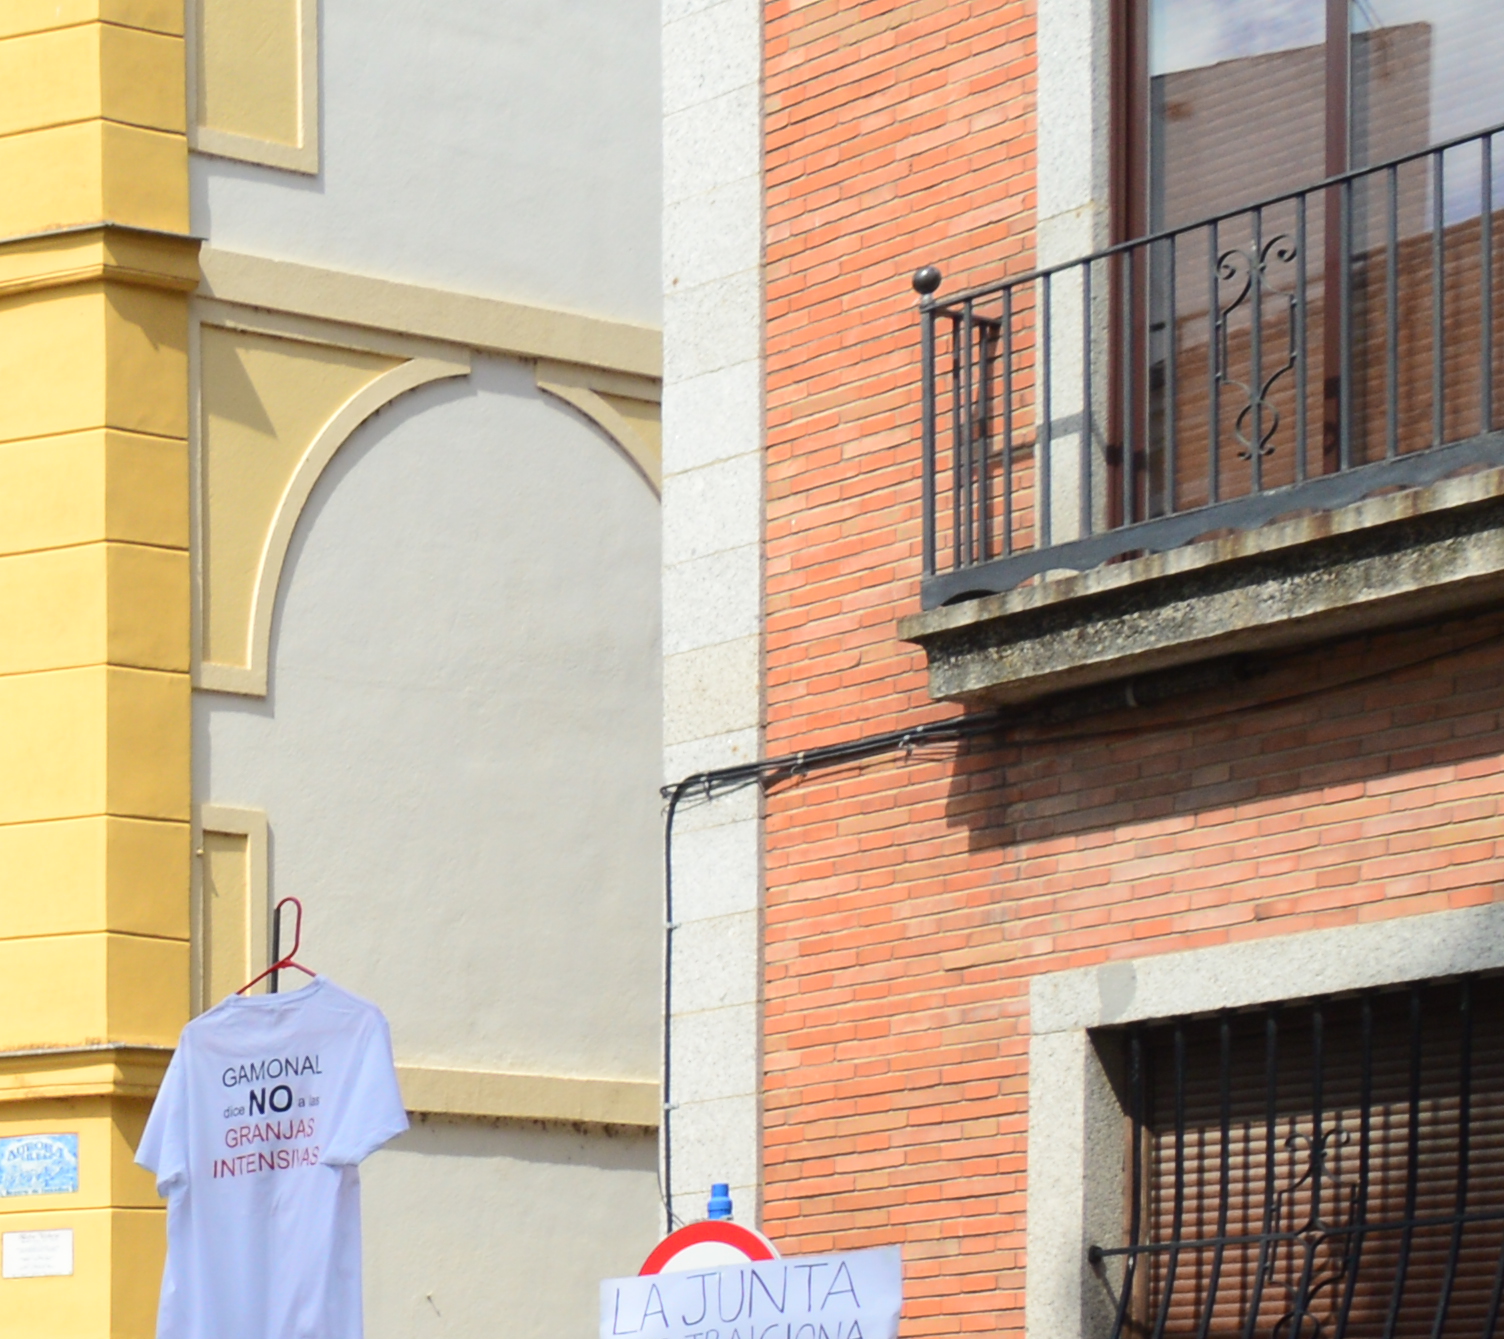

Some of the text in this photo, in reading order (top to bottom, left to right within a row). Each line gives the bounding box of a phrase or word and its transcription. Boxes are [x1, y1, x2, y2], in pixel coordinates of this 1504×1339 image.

[222, 1054, 322, 1087] GAMONAL
[223, 1104, 246, 1119] dice
[248, 1085, 293, 1117] NO
[225, 1118, 316, 1149] GRANJAS
[212, 1145, 320, 1179] INTENSIVAS
[612, 1260, 861, 1336] LA JUNTA
